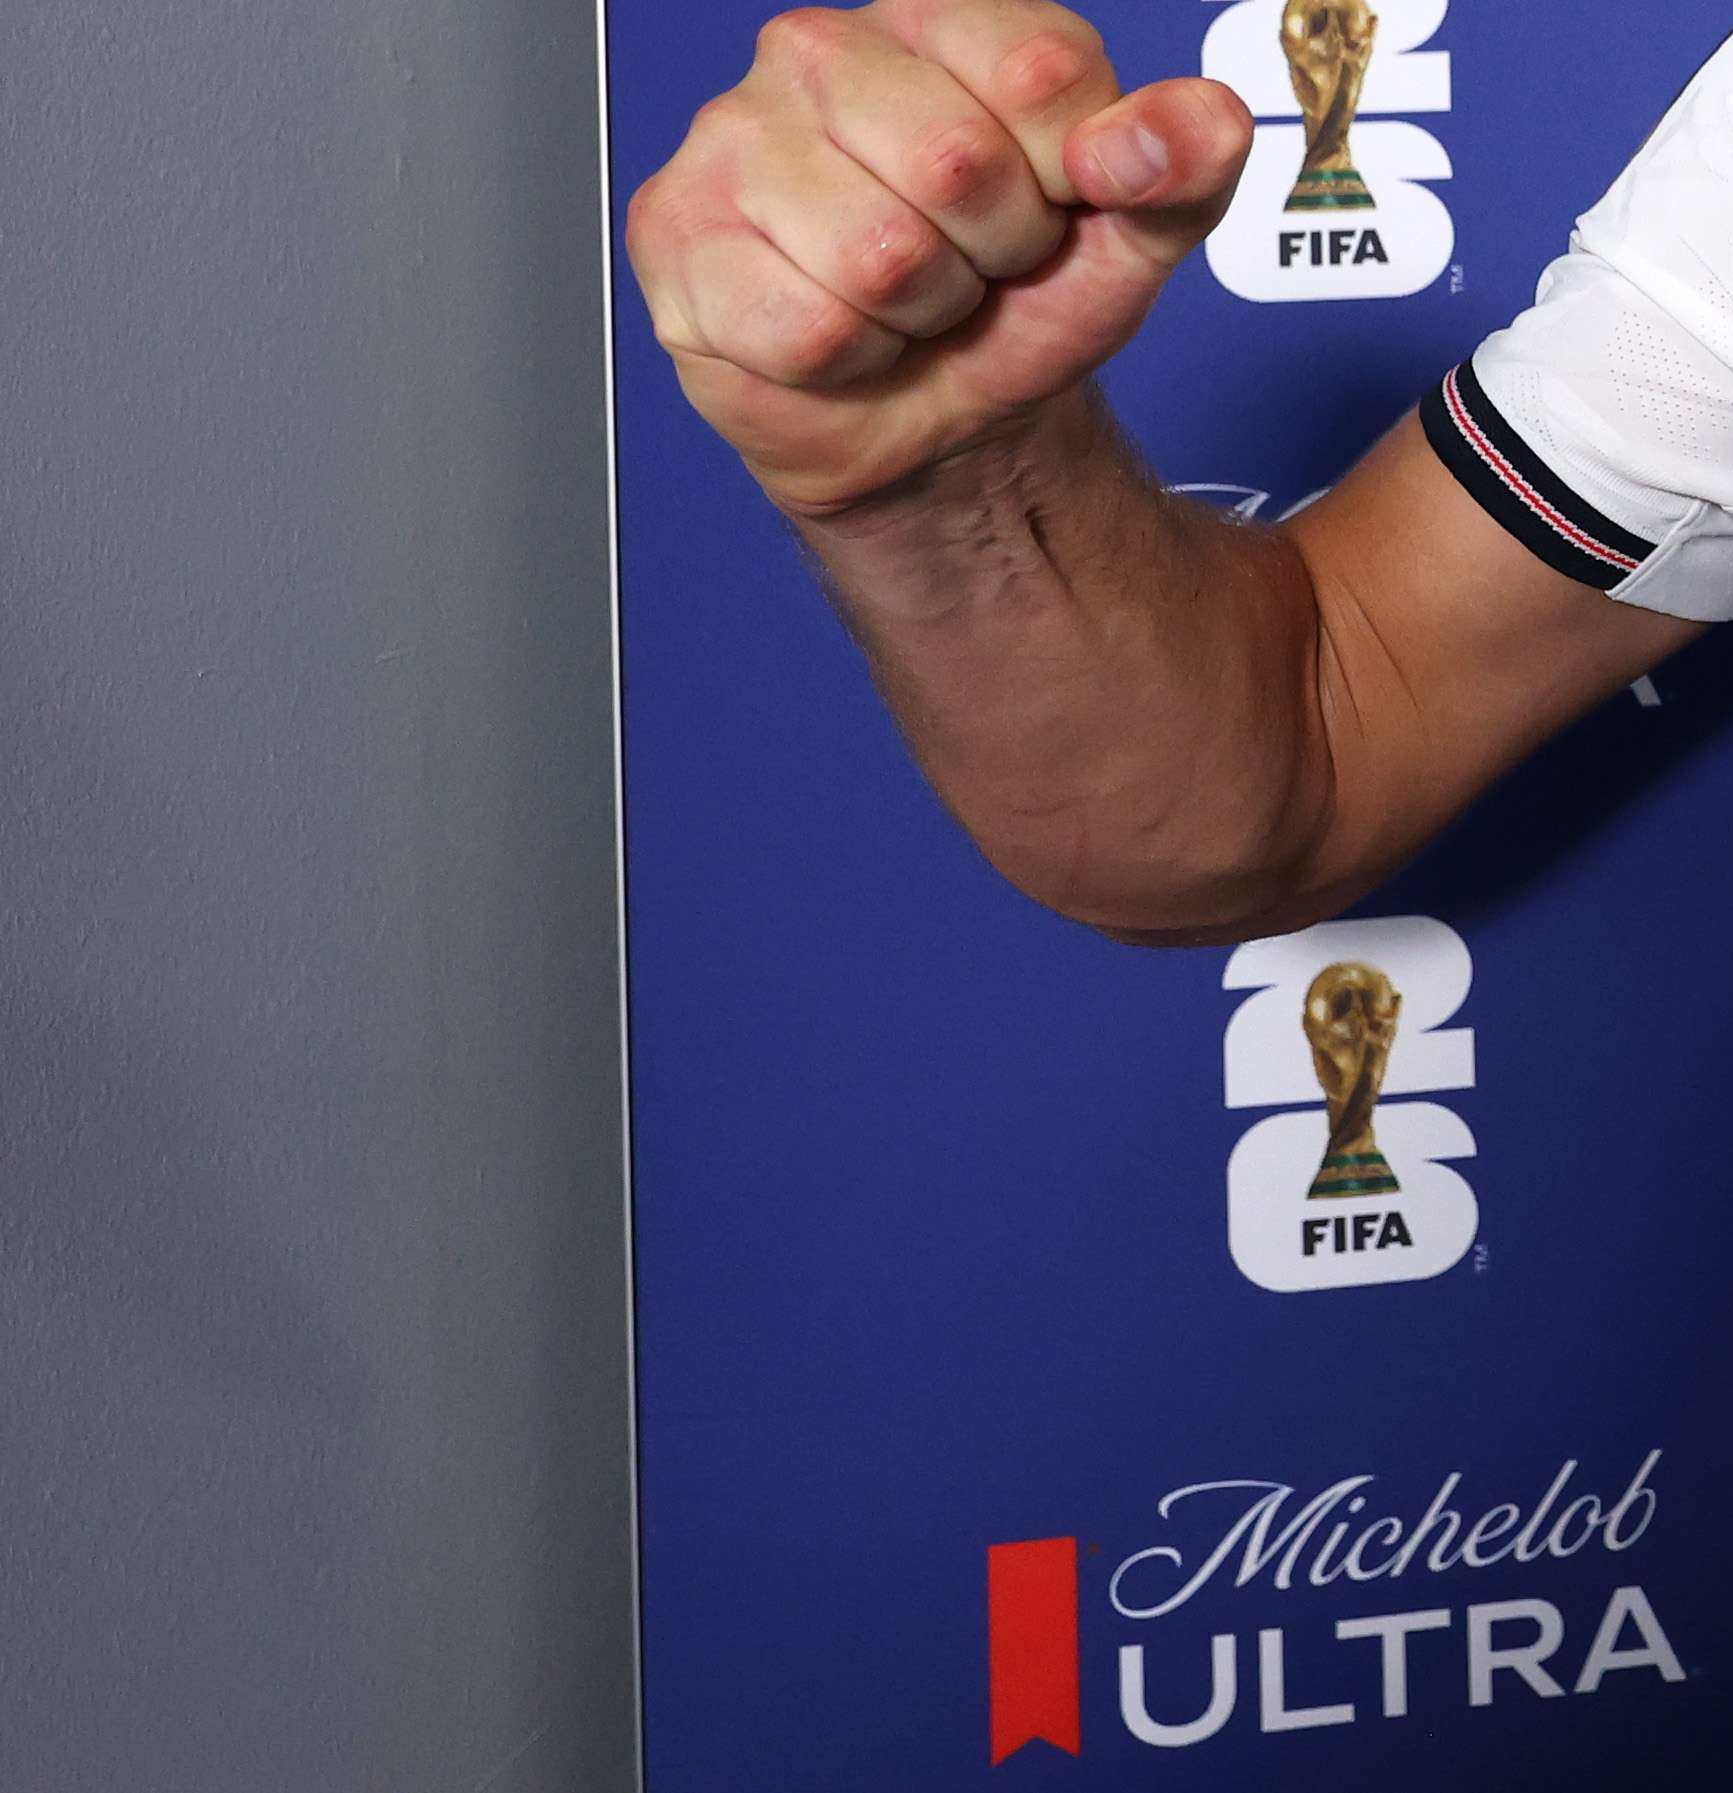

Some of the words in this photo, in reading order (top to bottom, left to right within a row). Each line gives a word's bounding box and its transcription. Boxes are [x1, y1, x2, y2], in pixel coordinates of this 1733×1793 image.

[1280, 230, 1388, 267] FIFA
[1303, 1212, 1412, 1256] FIFA
[1110, 1449, 1661, 1618] Michelob
[1119, 1587, 1685, 1747] ULTRA
